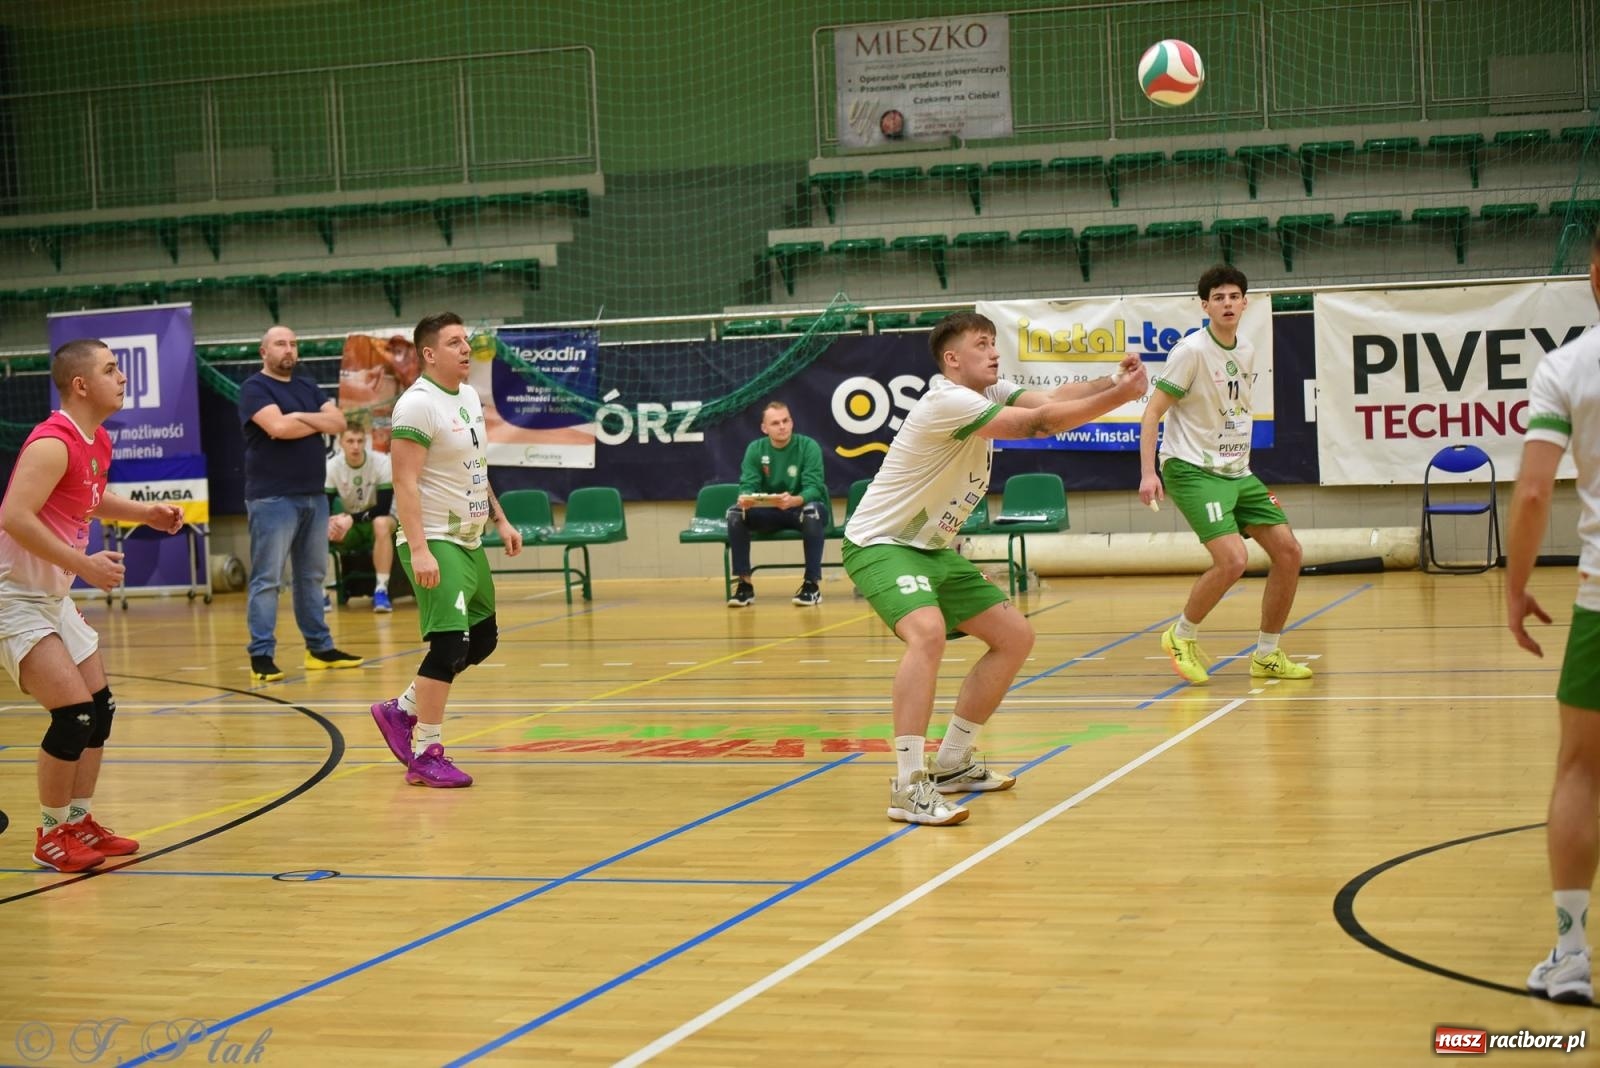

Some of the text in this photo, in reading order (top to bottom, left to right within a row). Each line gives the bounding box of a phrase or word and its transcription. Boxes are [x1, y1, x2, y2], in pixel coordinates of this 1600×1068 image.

[856, 23, 988, 57] MIESZKO
[1018, 316, 1210, 354] instal-te
[1013, 375, 1025, 385] 32
[1028, 375, 1051, 385] 414
[1227, 380, 1239, 400] 11
[595, 388, 705, 445] ÓRZ
[120, 423, 184, 441] możliwości
[470, 427, 479, 450] 4
[1205, 501, 1223, 523] 11
[896, 574, 933, 595] 99
[454, 590, 466, 616] 4
